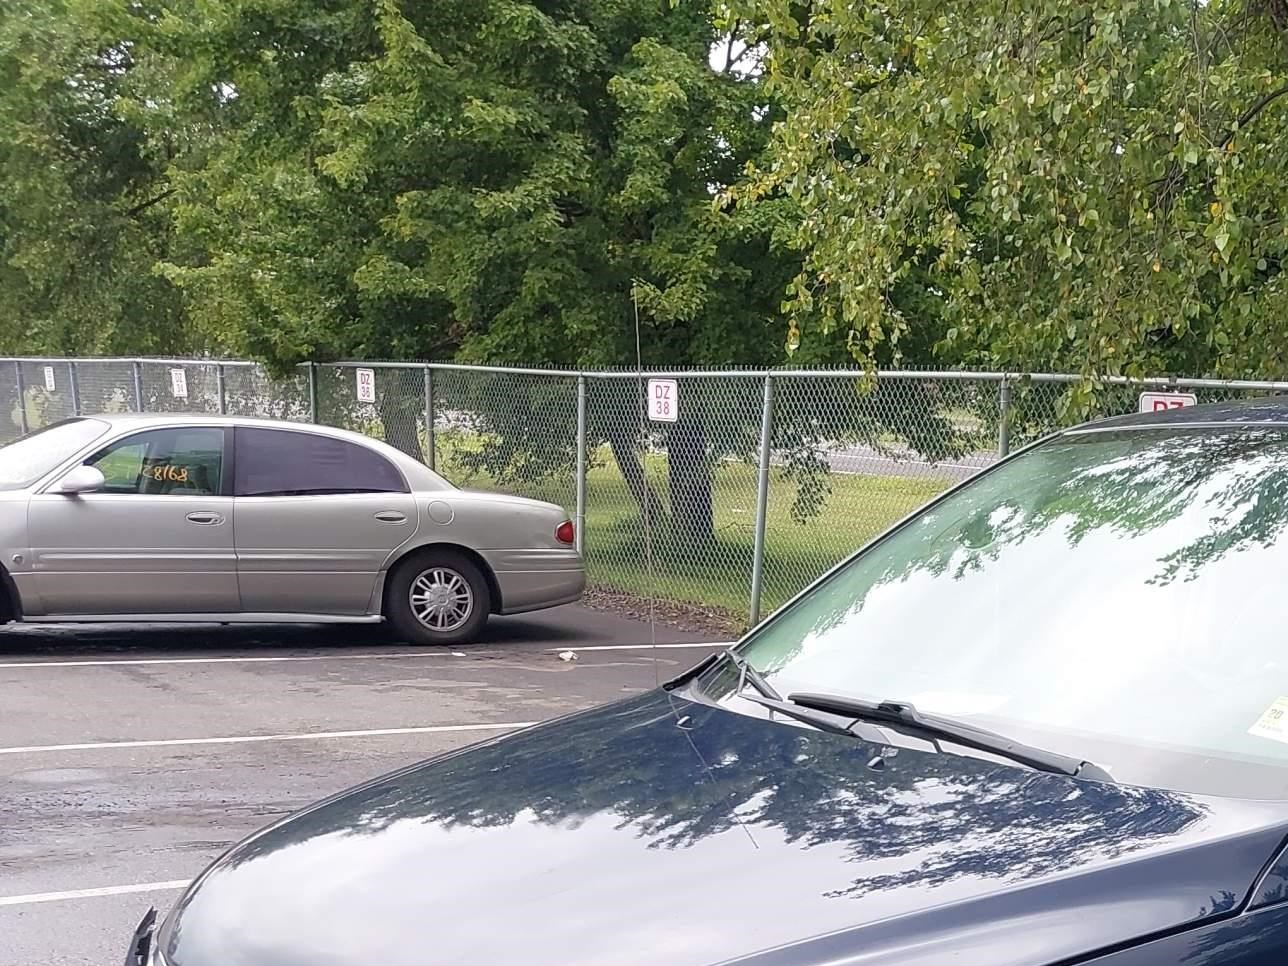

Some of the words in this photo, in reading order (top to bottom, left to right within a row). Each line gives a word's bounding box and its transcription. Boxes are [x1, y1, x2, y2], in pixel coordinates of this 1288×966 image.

[360, 373, 371, 385] DZ
[655, 385, 670, 399] DZ
[656, 401, 670, 415] 38
